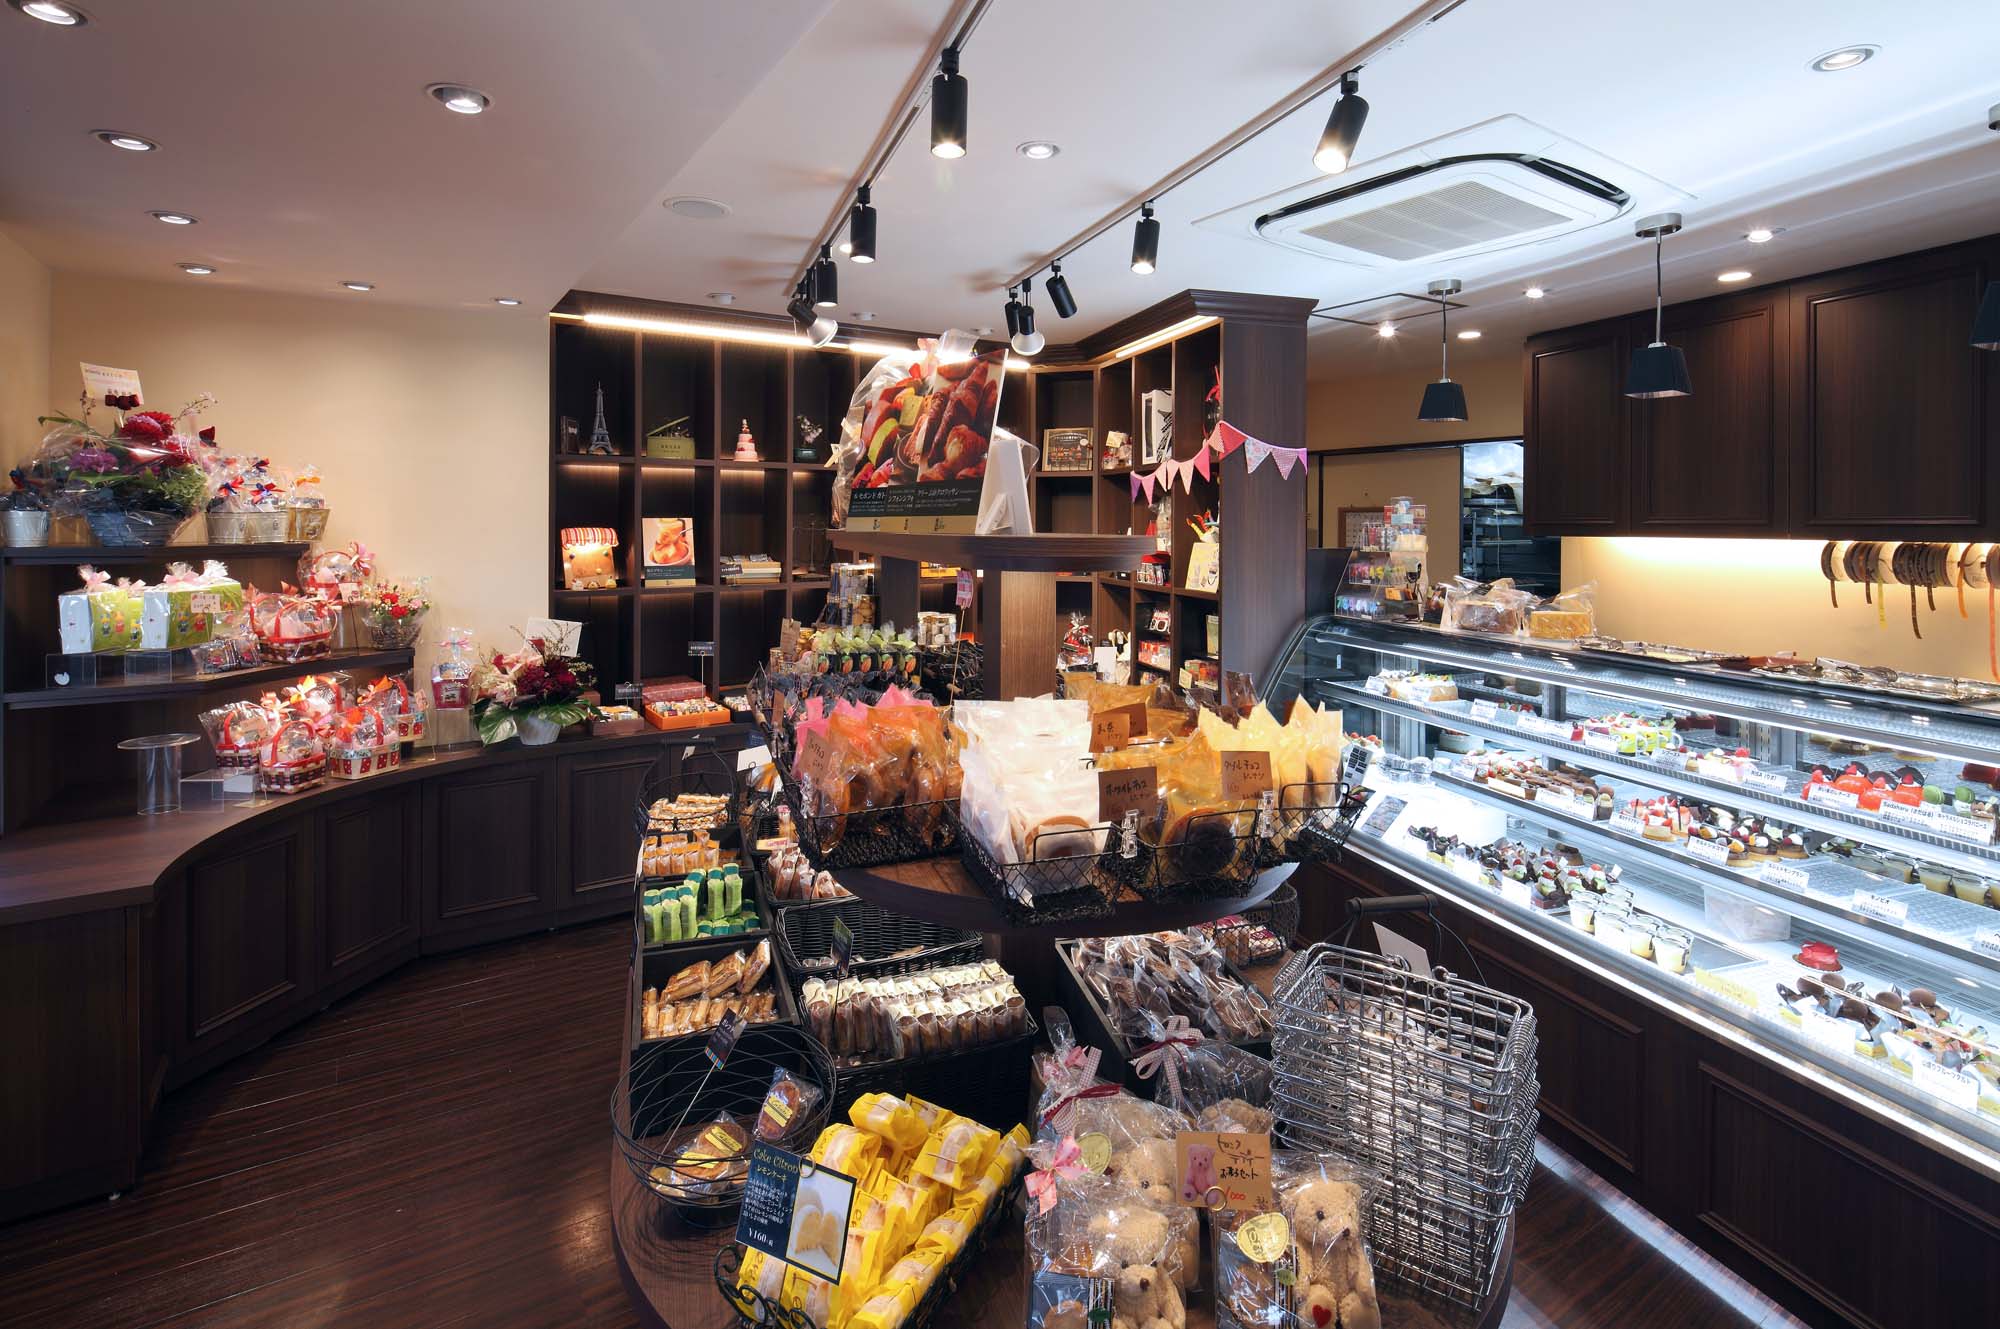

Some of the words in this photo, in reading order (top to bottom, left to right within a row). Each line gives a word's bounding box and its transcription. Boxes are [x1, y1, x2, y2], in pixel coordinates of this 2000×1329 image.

[1882, 801, 1909, 813] Sadaharu
[753, 1149, 773, 1164] Cake
[773, 1155, 799, 1174] Citron
[756, 1164, 788, 1182] レモンケーキ
